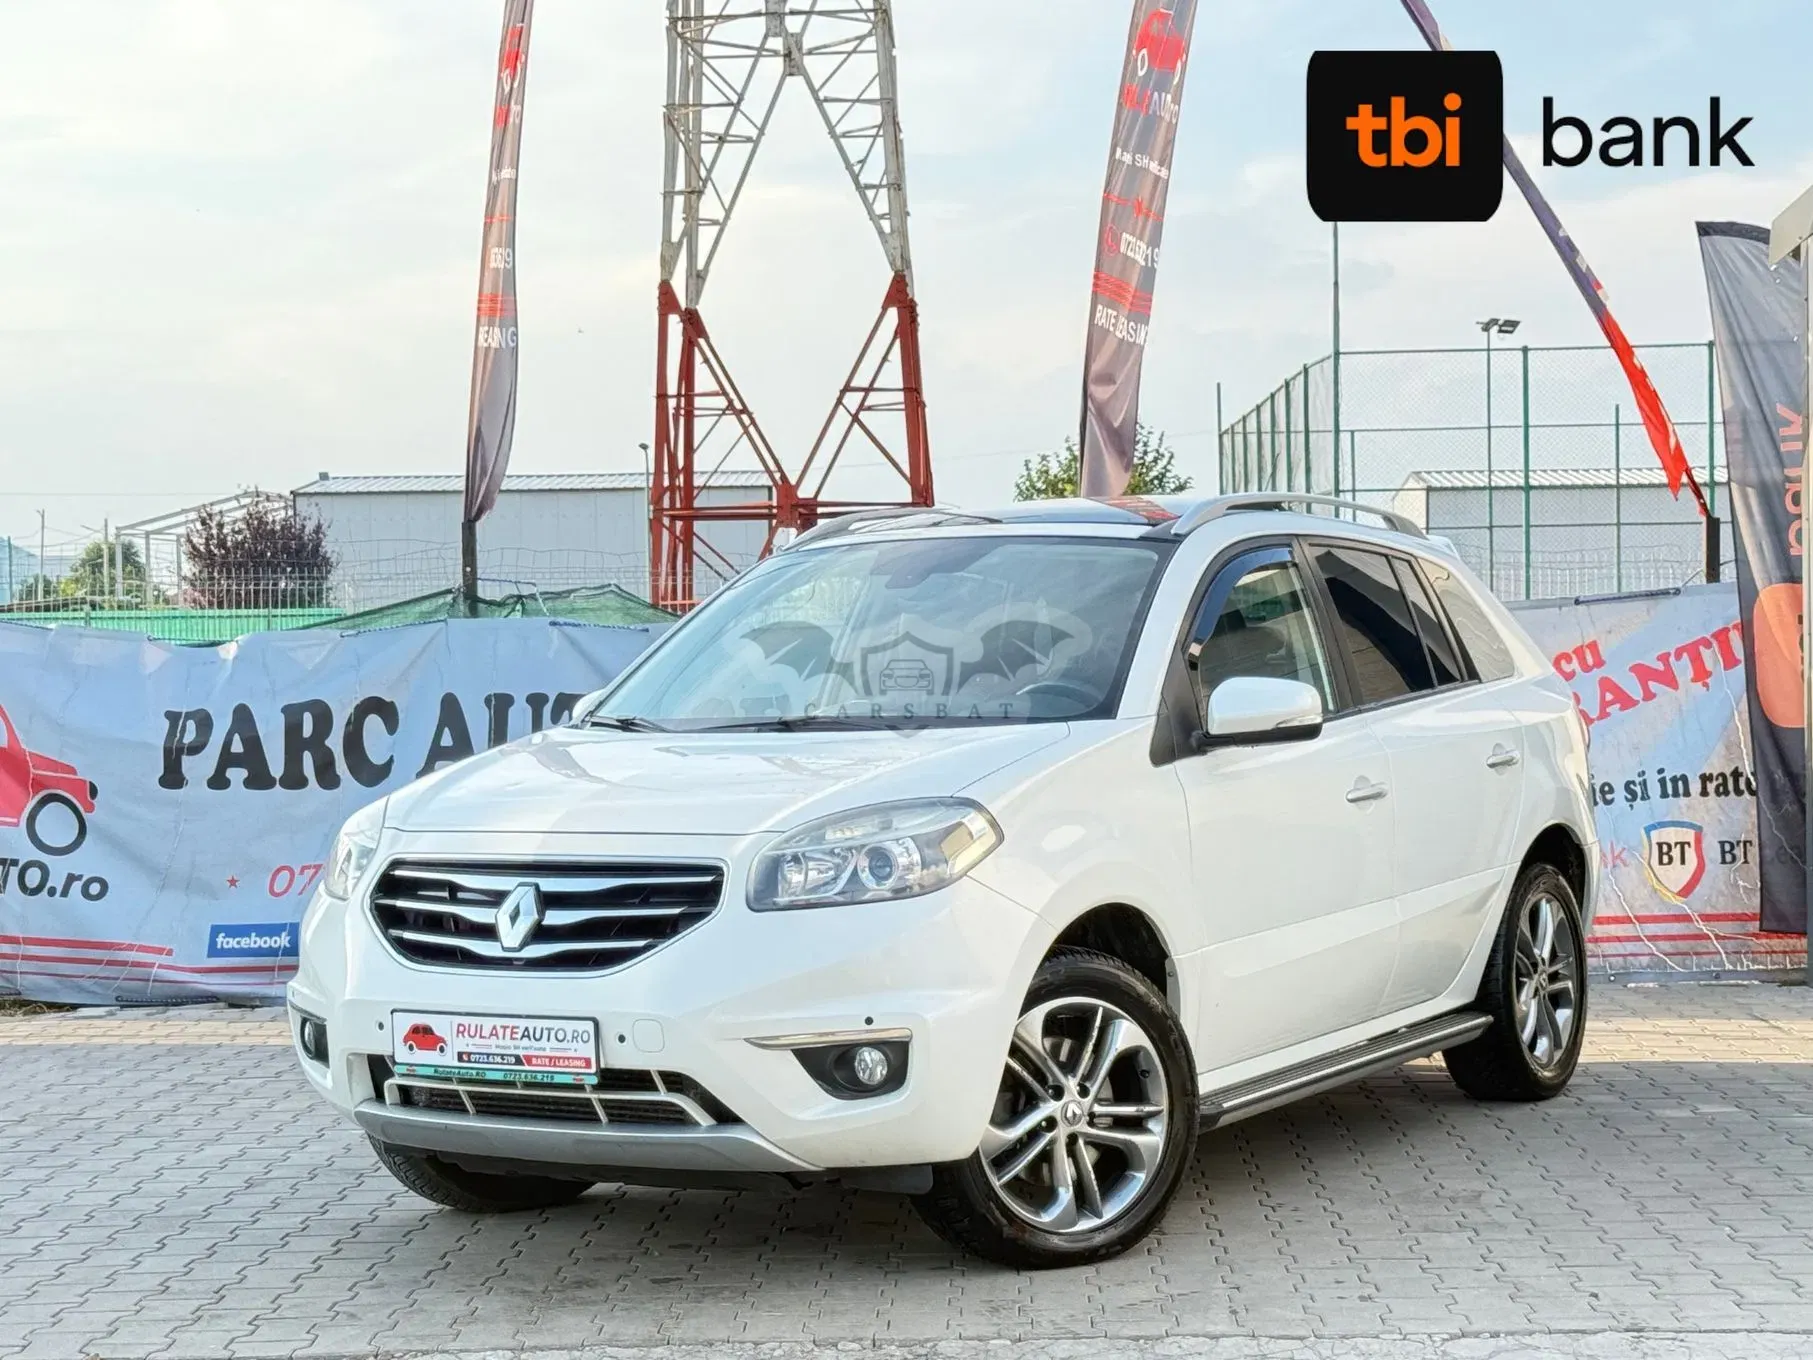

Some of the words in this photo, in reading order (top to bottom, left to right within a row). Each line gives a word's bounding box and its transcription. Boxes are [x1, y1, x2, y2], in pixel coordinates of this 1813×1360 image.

[1552, 639, 1606, 682] cu
[158, 695, 400, 790] PARC
[1656, 841, 1691, 866] BT
[1718, 840, 1752, 865] BT
[215, 931, 292, 950] facebook
[456, 1023, 591, 1044] RULATEAUTO.RO
[470, 1054, 516, 1065] 0723.636.219
[532, 1057, 550, 1066] RATE
[556, 1058, 586, 1068] LEASING
